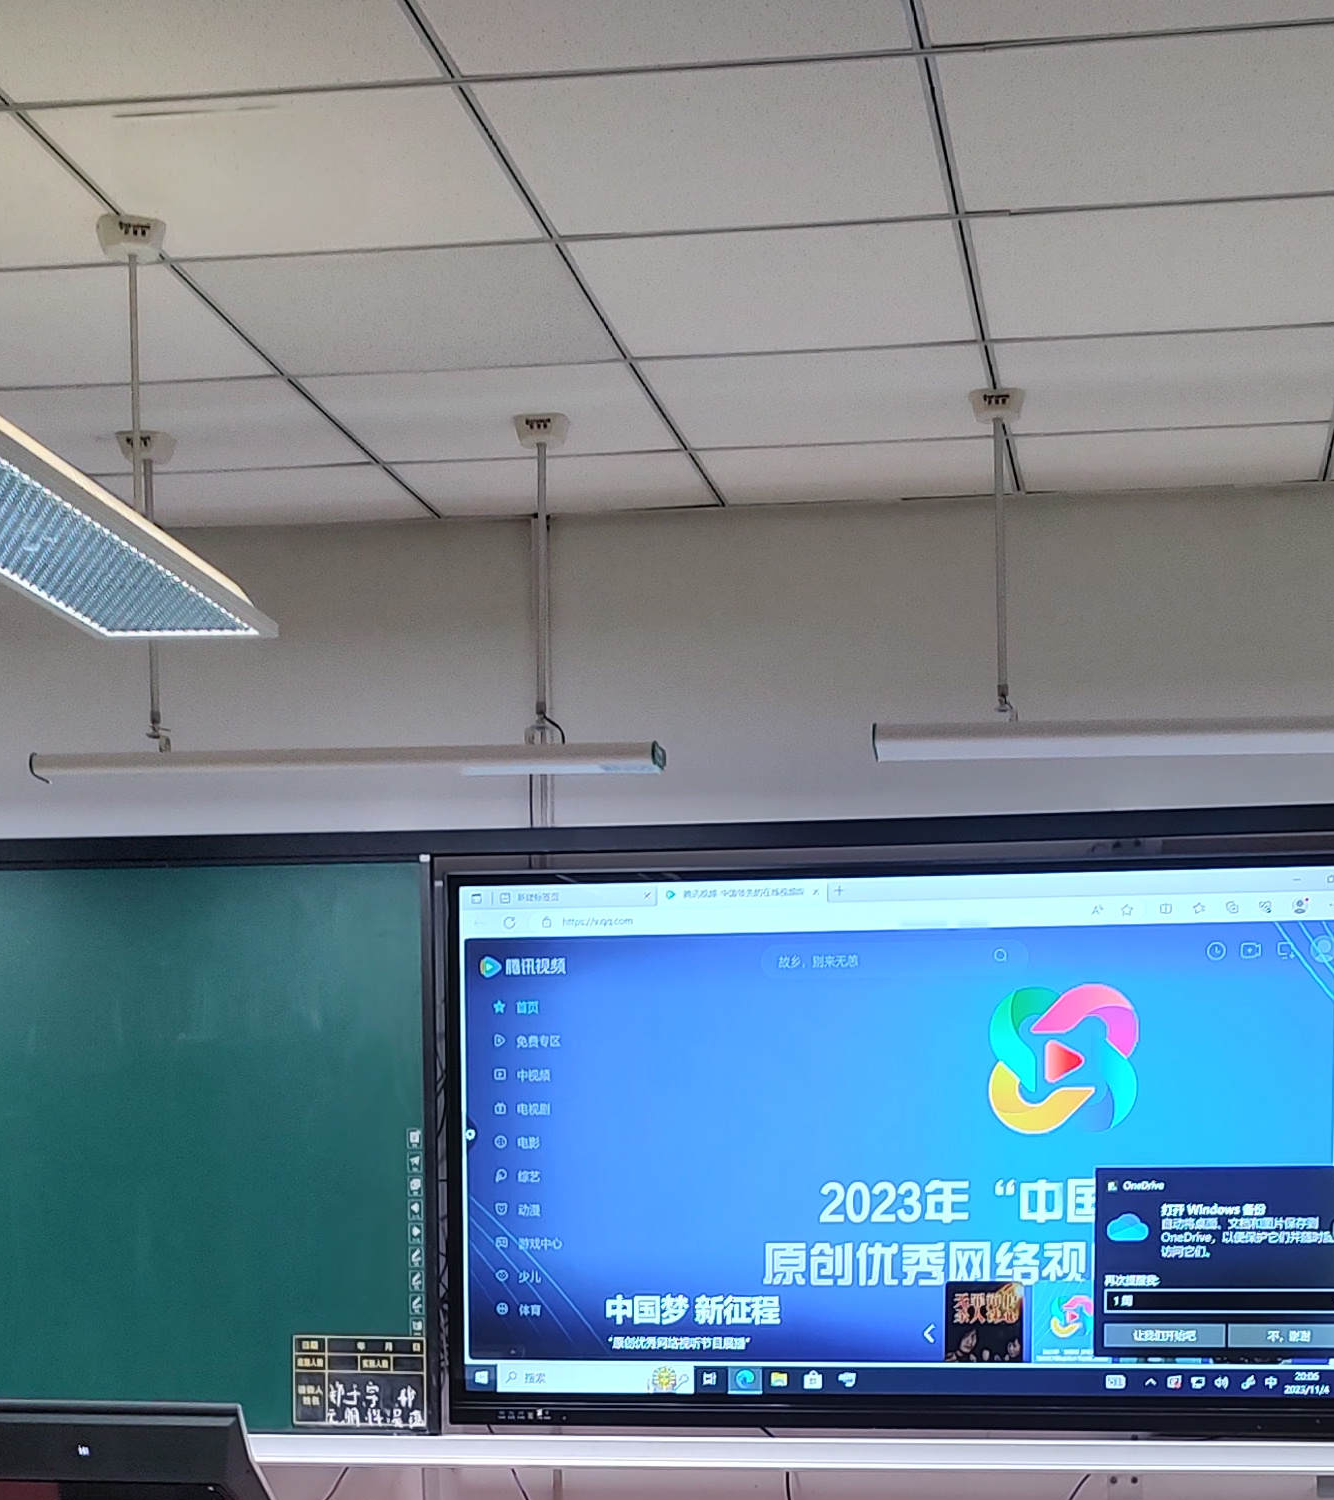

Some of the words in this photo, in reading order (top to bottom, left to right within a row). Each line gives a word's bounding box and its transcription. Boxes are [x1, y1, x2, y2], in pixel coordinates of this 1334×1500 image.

[505, 957, 567, 977] 腾讯视频
[515, 1001, 540, 1015] 首页
[515, 1033, 562, 1048] 免费专区
[516, 1067, 551, 1082] 中视频
[516, 1102, 551, 1116] 电视剧
[517, 1135, 541, 1149] 电影
[517, 1169, 541, 1184] 综艺
[1122, 1180, 1166, 1192] OneDrive
[517, 1203, 542, 1218] 动漫
[1160, 1203, 1185, 1217] 打开
[1186, 1203, 1241, 1217] Windows
[1242, 1203, 1267, 1216] 备份
[517, 1236, 563, 1251] 游戏中心
[762, 1240, 1096, 1288] 原创优秀网络视
[518, 1270, 542, 1285] 少儿
[518, 1303, 542, 1317] 体育
[605, 1293, 690, 1326] 中国梦
[692, 1293, 781, 1326] 新征程
